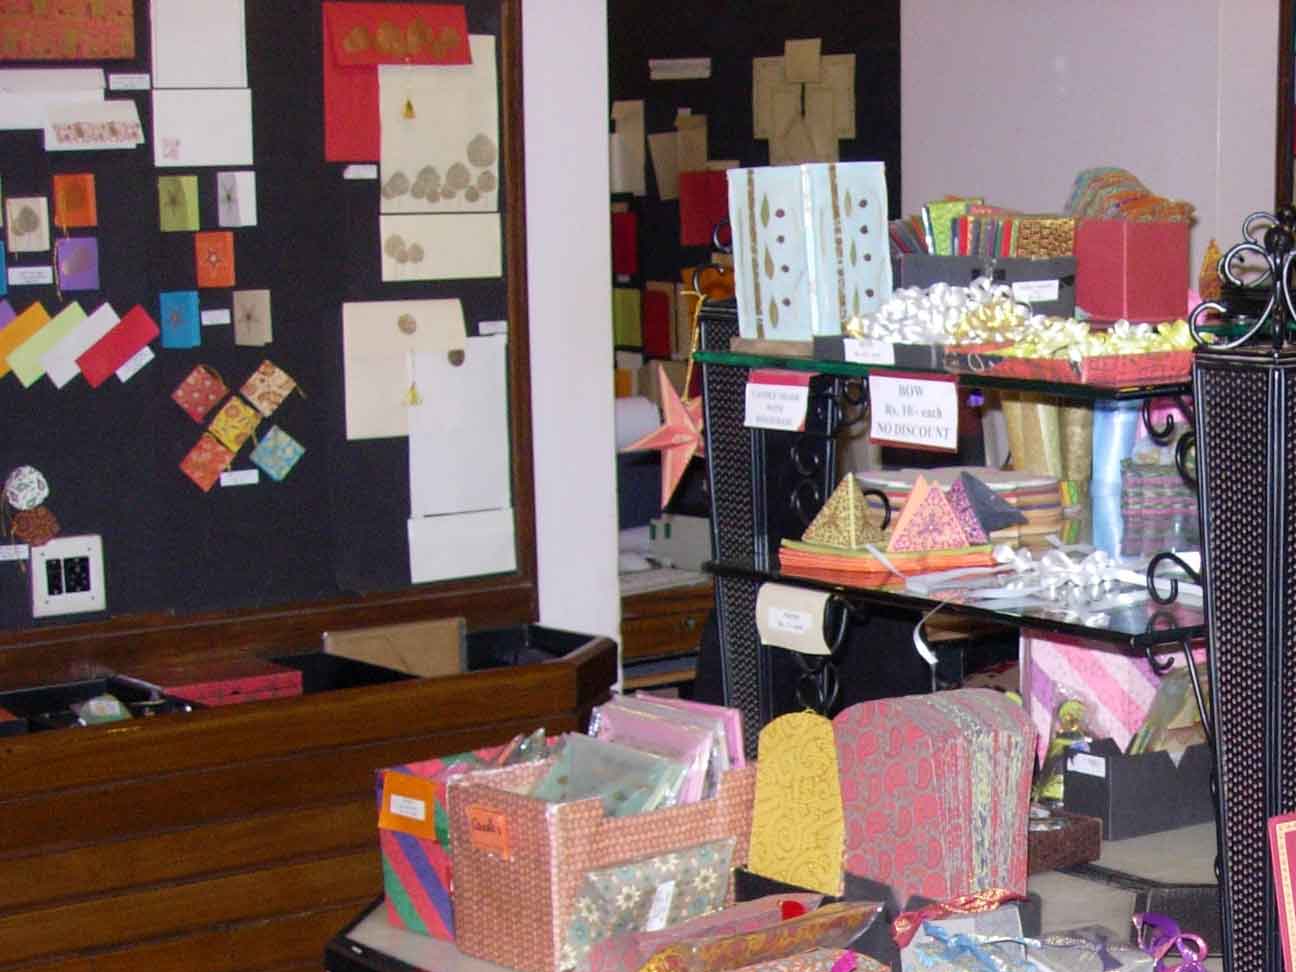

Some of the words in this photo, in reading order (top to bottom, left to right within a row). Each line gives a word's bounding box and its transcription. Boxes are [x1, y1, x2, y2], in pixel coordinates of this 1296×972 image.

[898, 383, 923, 397] BOW
[877, 422, 892, 433] NO
[894, 423, 950, 440] DISCOUNT
